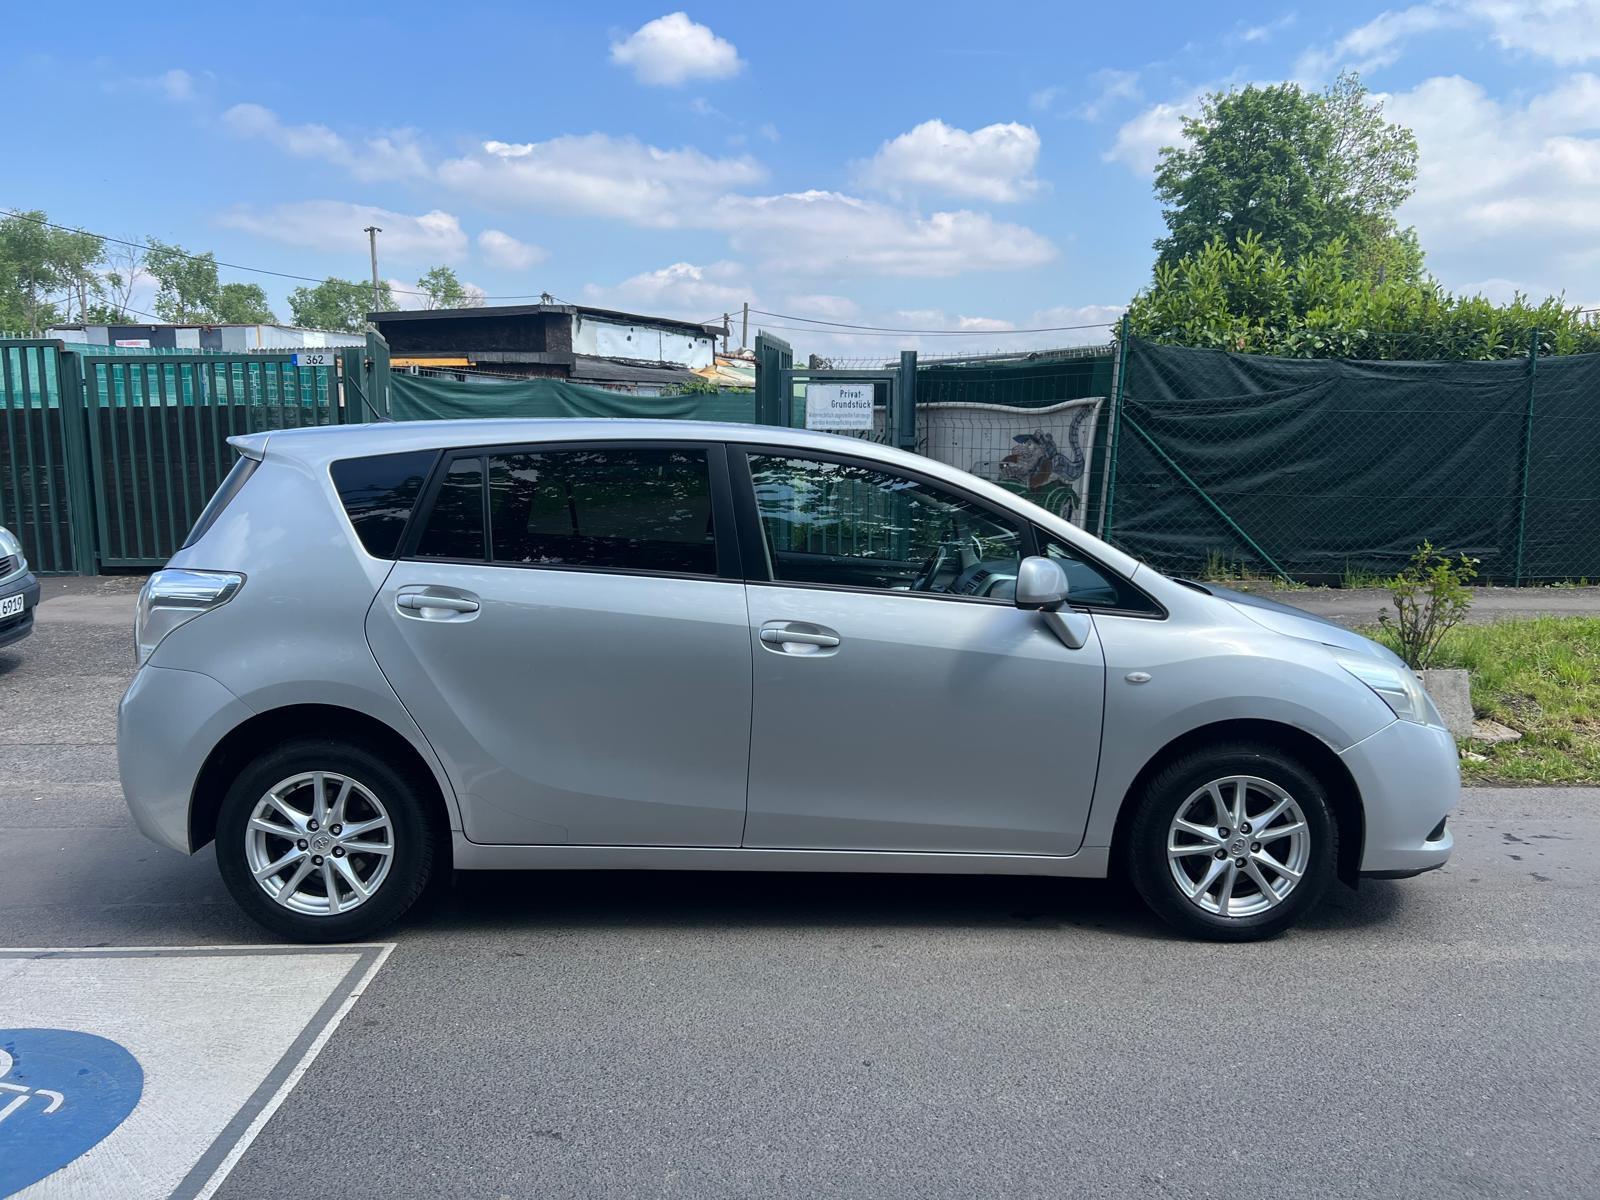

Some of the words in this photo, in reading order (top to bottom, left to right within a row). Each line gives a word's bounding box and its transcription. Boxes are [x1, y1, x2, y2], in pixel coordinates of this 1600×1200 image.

[306, 355, 324, 364] 362
[840, 389, 864, 398] Privat-
[831, 400, 871, 408] Grundstück
[3, 597, 22, 614] 6919
